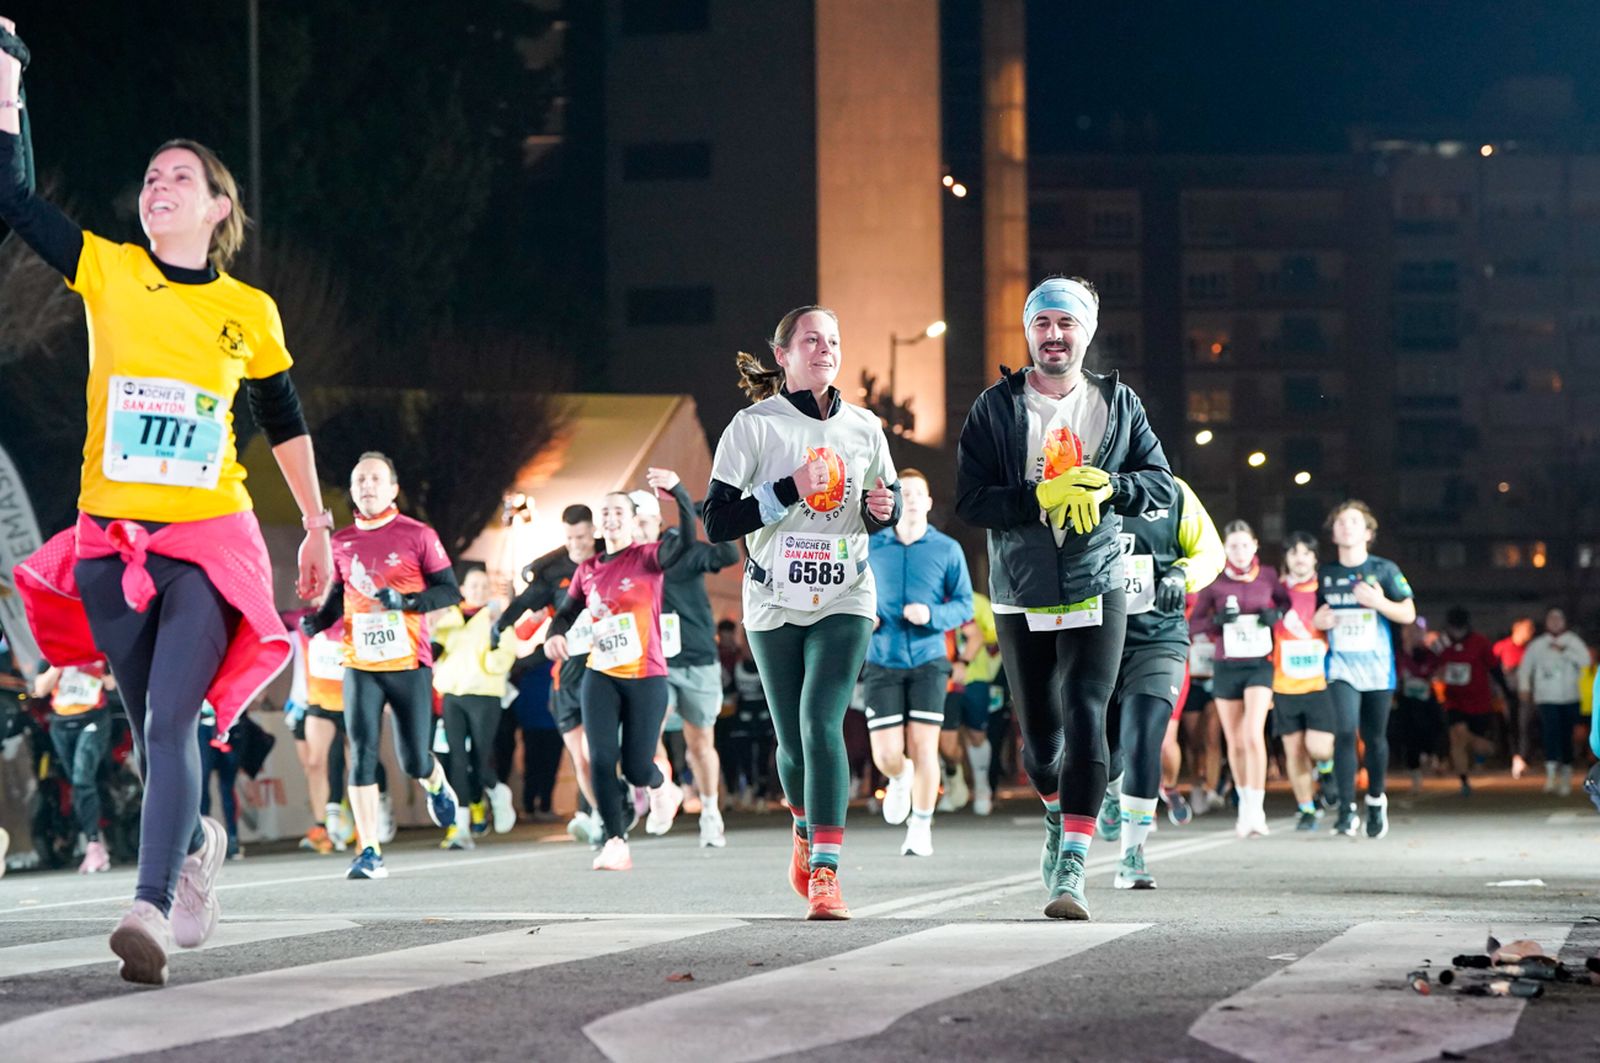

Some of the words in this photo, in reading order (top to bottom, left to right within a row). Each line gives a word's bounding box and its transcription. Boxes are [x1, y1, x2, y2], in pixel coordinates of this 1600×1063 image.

[138, 389, 171, 400] OCHE
[123, 400, 144, 410] SAN
[140, 415, 197, 448] 7777
[794, 540, 820, 550] NOCHE
[820, 542, 832, 551] DE
[784, 550, 801, 559] SAN
[788, 560, 846, 585] 6583
[363, 629, 396, 646] 7230
